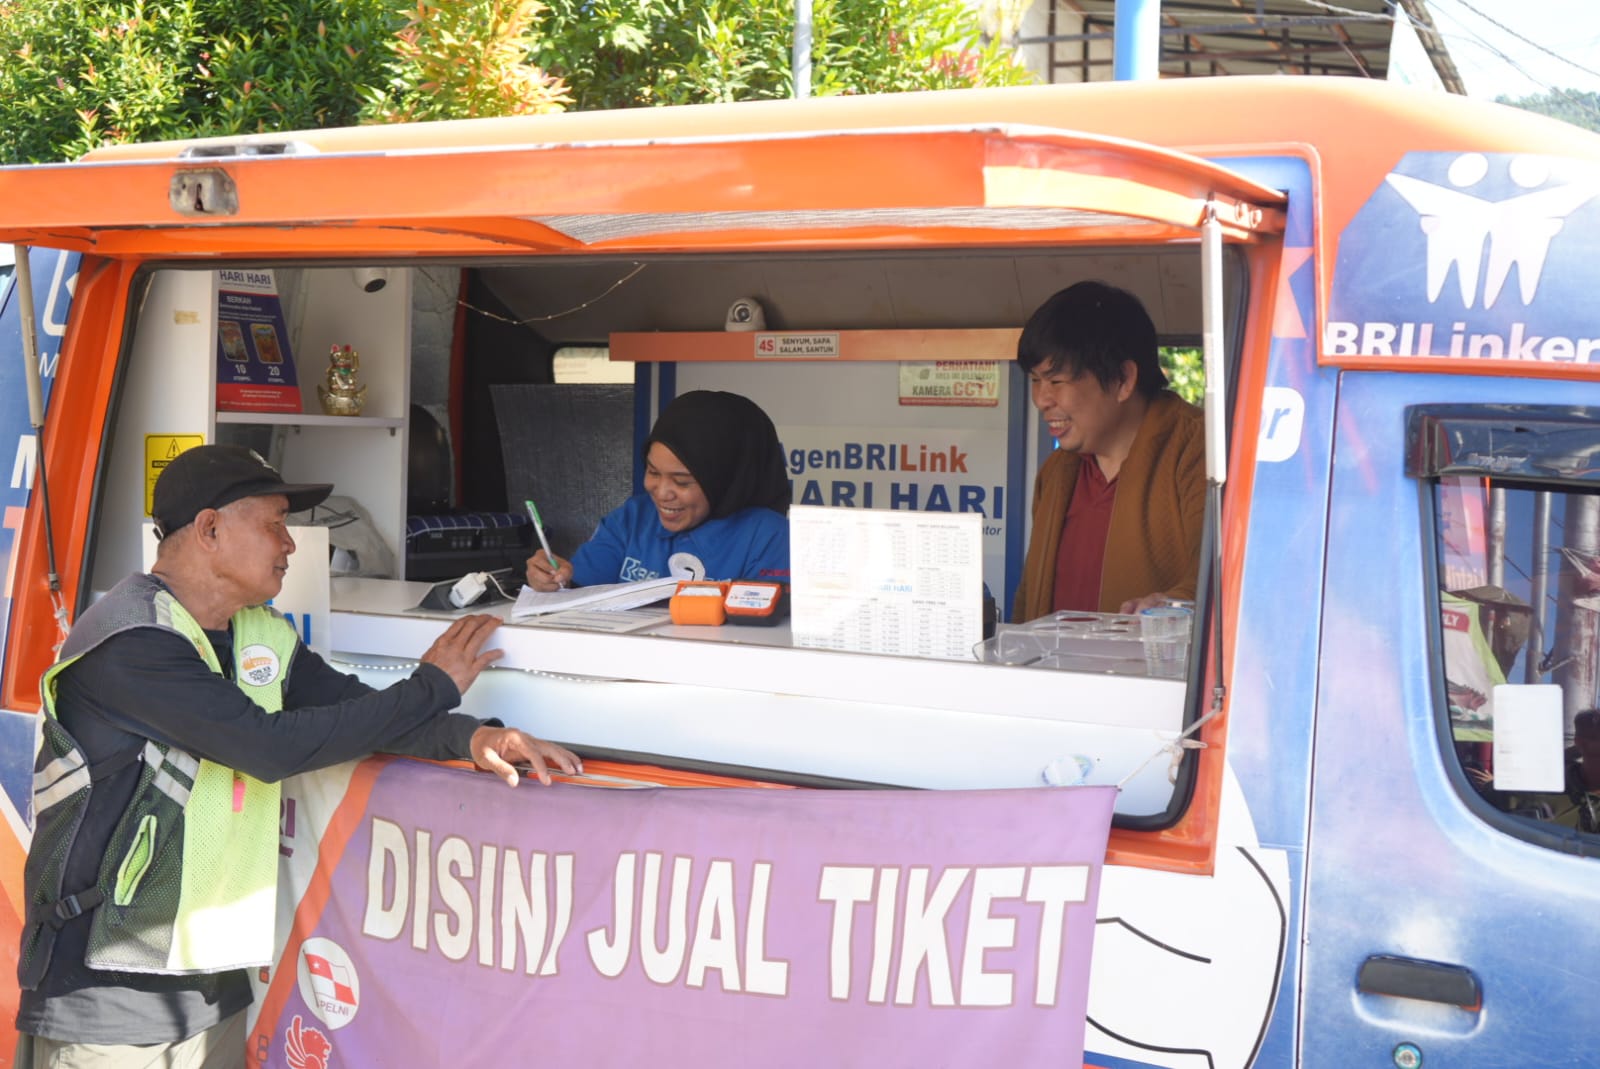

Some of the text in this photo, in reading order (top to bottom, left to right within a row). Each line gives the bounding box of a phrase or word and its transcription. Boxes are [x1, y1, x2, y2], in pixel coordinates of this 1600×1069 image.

[247, 273, 272, 284] HARI
[759, 339, 774, 352] 4S
[813, 337, 831, 345] SAPA
[235, 363, 280, 376] 10 20
[912, 382, 996, 396] KAMERA CCTV
[891, 482, 1004, 519] HARI
[362, 815, 1090, 1006] DISINI JUAL TIKET
[319, 1000, 350, 1016] PELNI
